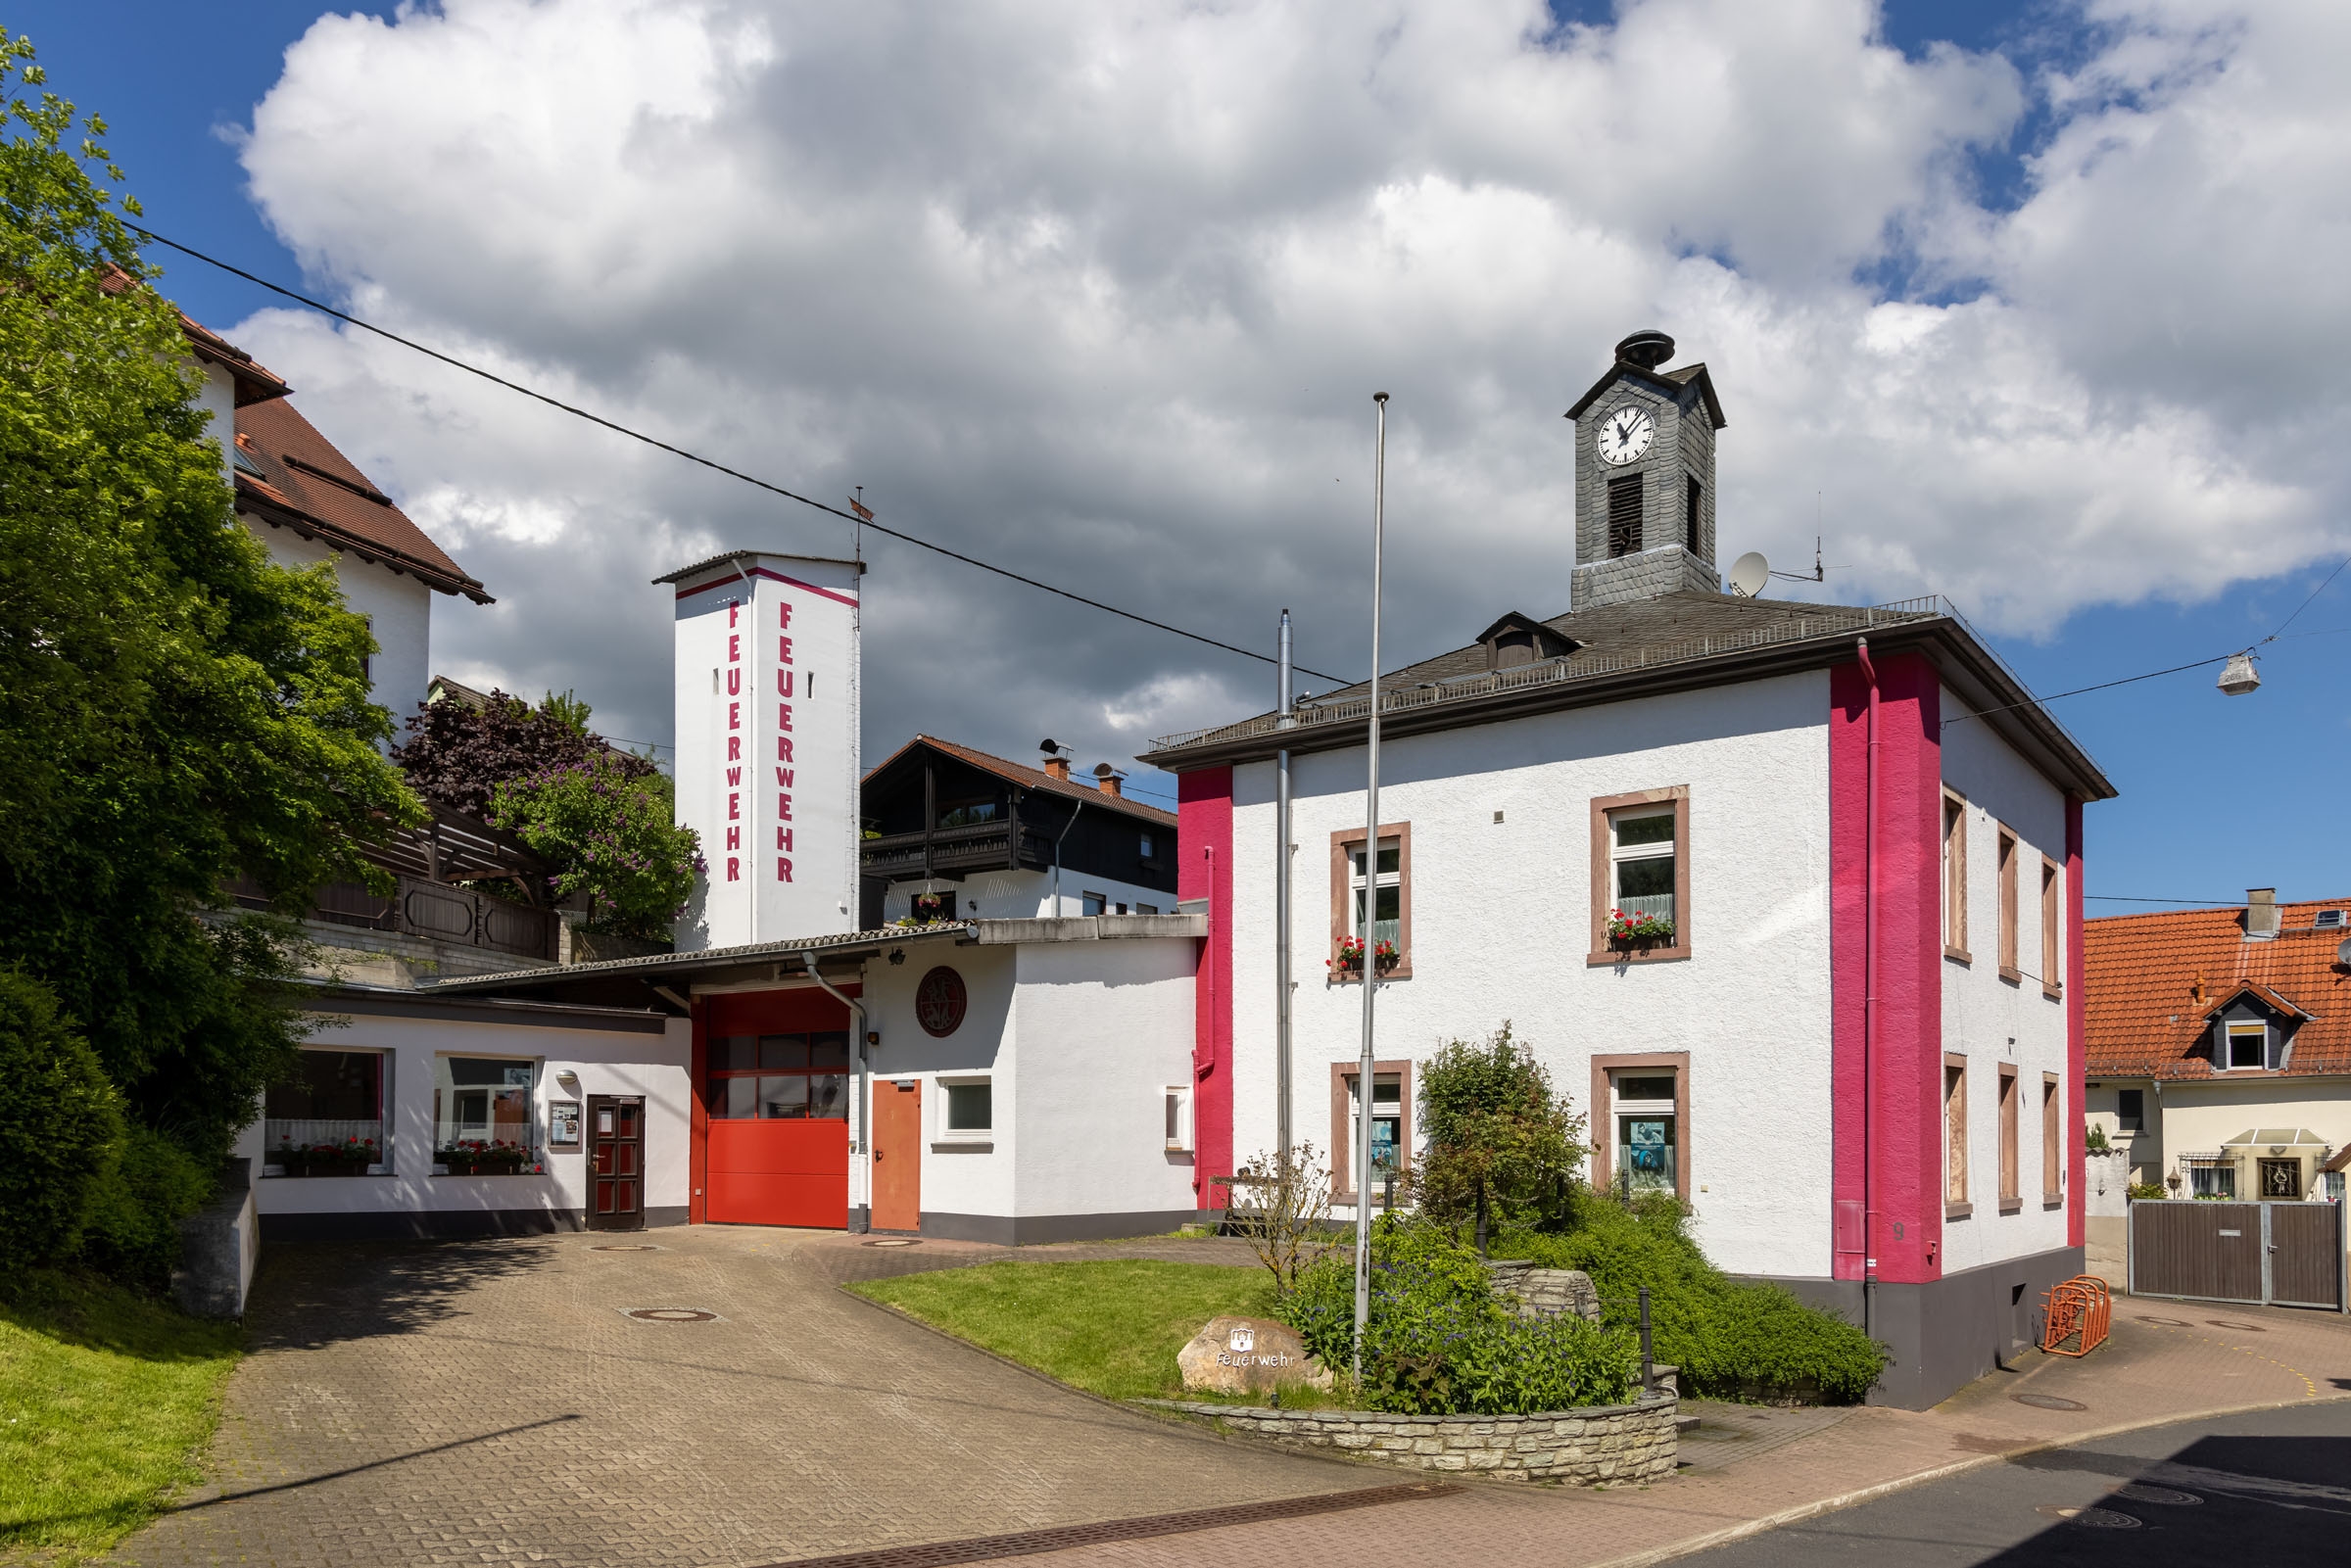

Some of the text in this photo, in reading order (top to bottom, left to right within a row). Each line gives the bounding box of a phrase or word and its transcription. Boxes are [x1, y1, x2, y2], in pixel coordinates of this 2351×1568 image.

[727, 600, 742, 882] FEUERWEHR
[776, 602, 794, 883] FEUERWEHR
[1894, 1222, 1904, 1241] 9
[1216, 1351, 1295, 1368] Feuerwehr
